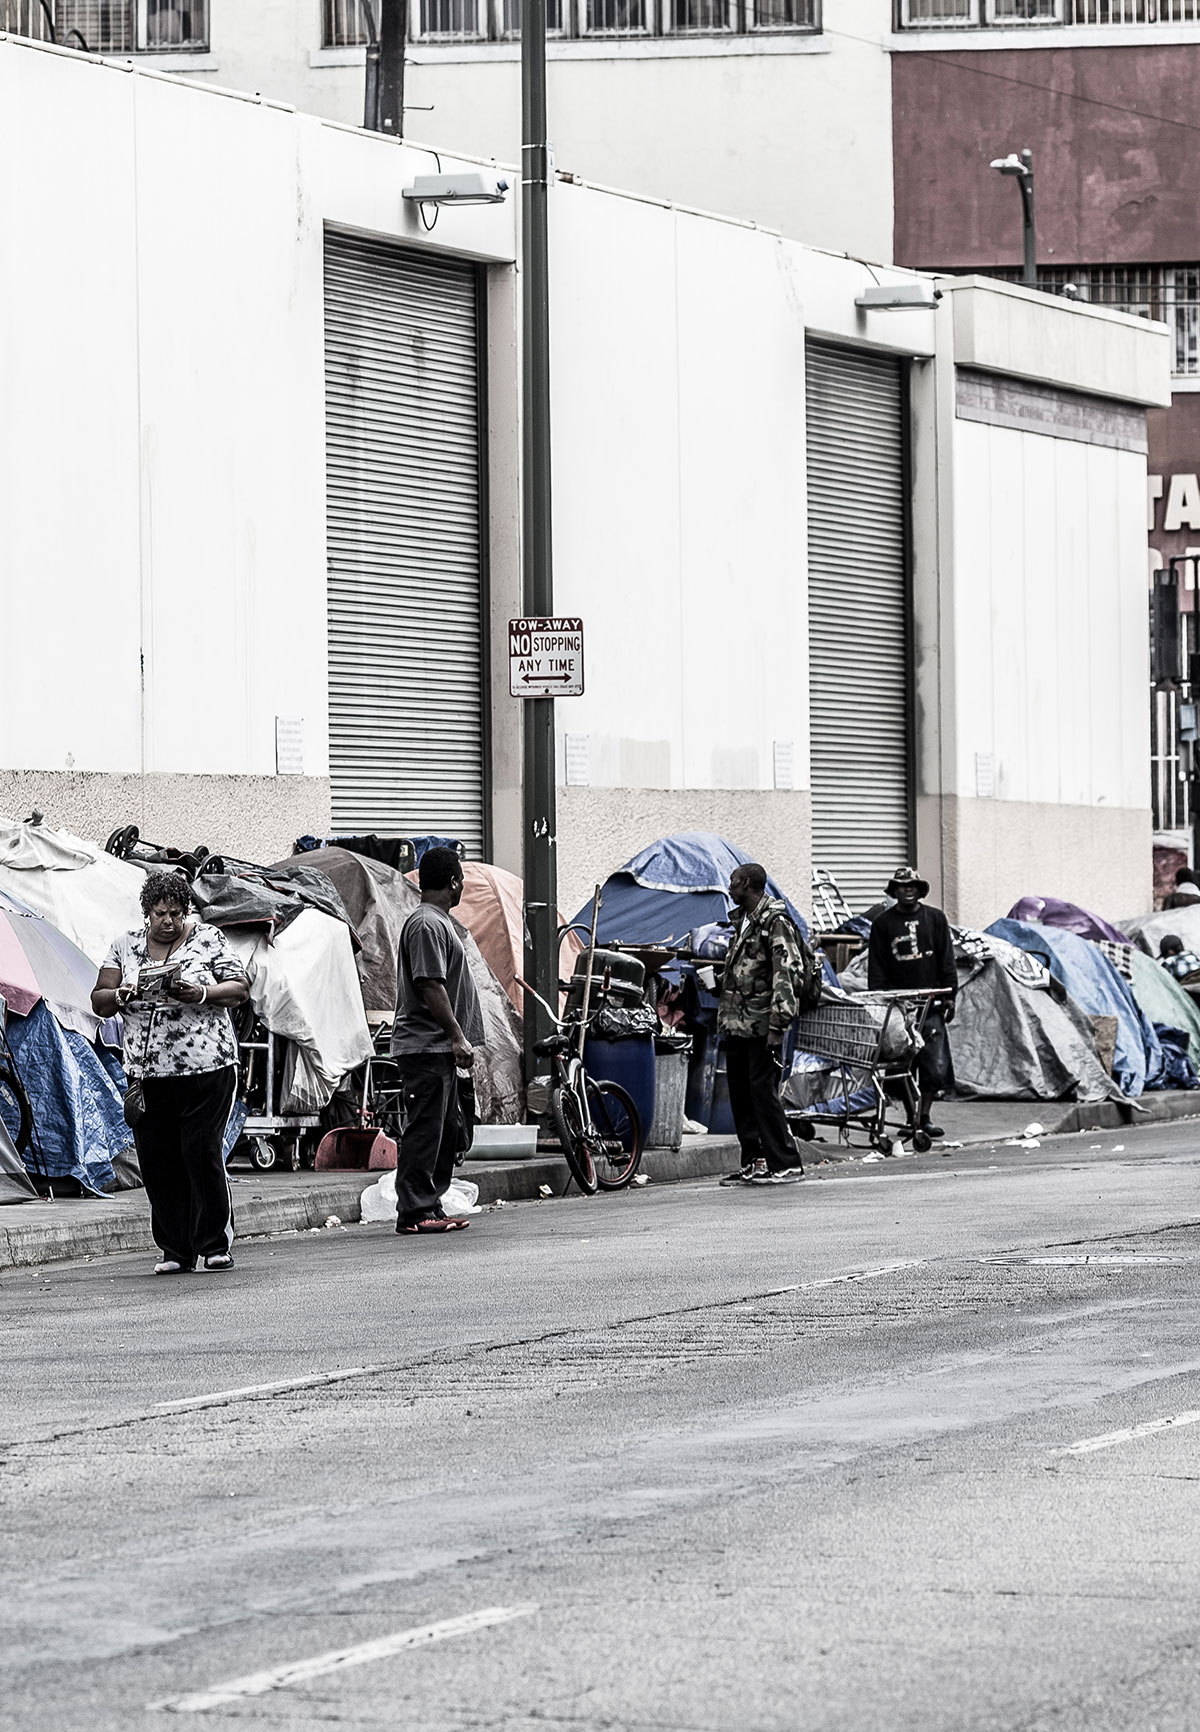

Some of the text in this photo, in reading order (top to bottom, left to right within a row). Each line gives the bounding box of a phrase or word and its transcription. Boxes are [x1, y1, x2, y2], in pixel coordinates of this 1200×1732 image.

[510, 620, 580, 631] TOW-AWAY
[510, 634, 580, 655] NO STOPPING
[518, 659, 575, 672] ANY TIME
